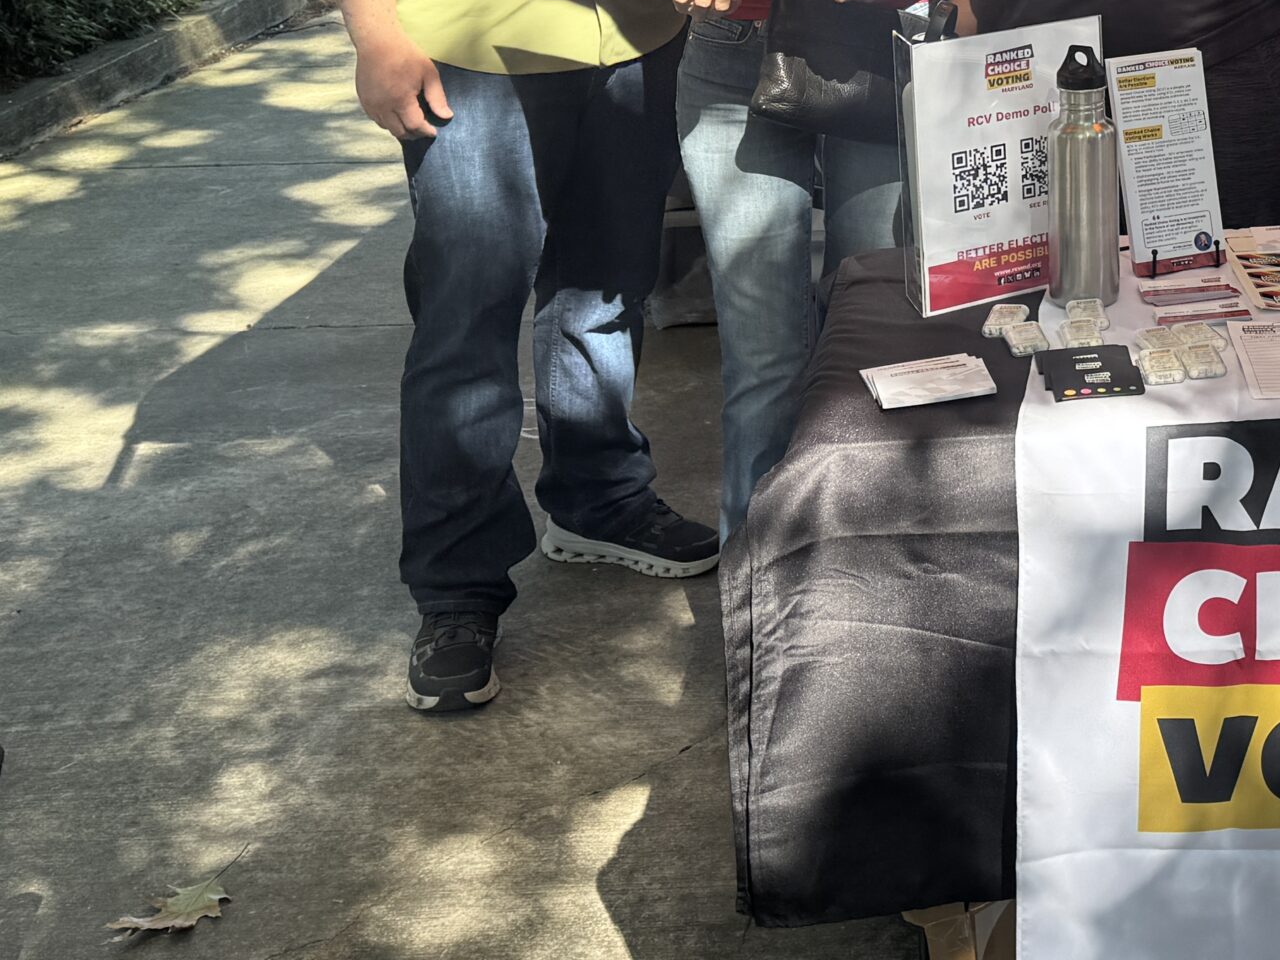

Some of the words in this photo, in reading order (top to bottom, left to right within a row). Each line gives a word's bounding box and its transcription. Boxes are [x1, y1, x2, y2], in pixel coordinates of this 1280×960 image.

[987, 48, 1032, 64] RANKED
[1169, 57, 1194, 65] VOTING
[987, 60, 1027, 75] CHOICE
[988, 72, 1030, 87] VOTING
[1001, 83, 1033, 93] MARYLAND
[968, 113, 992, 127] RCV
[996, 108, 1030, 122] Demo
[973, 211, 991, 220] VOTE
[957, 242, 1004, 260] BETTER
[1008, 232, 1049, 249] ELECTI
[973, 257, 997, 272] ARE
[1001, 246, 1049, 265] POSSIBL
